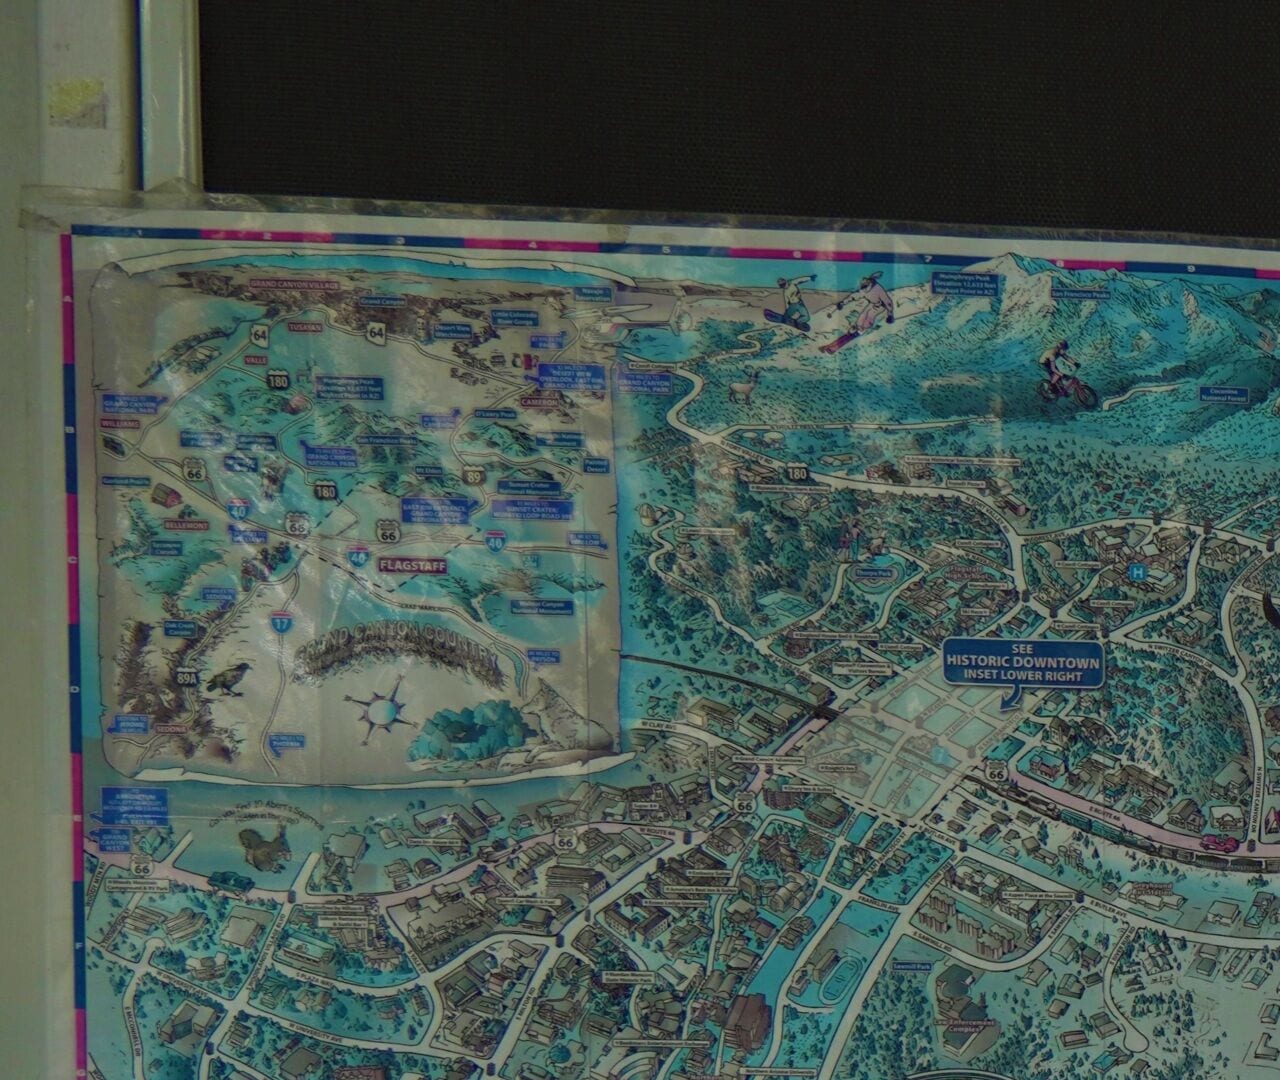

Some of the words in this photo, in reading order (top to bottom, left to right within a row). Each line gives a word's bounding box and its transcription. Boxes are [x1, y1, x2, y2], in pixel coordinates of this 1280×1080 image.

[253, 330, 267, 341] 64
[369, 327, 383, 338] 64
[316, 486, 336, 498] 180
[381, 532, 396, 541] 66
[380, 559, 447, 571] FLAGSTAFF
[275, 616, 287, 628] 17
[1011, 643, 1034, 654] SEE
[946, 654, 1010, 668] HISTORIC
[1013, 656, 1100, 670] DOWNTOWN
[177, 672, 198, 684] 89A
[964, 669, 999, 679] INSET
[1001, 670, 1042, 681] LOWER
[1045, 671, 1083, 682] RIGHT
